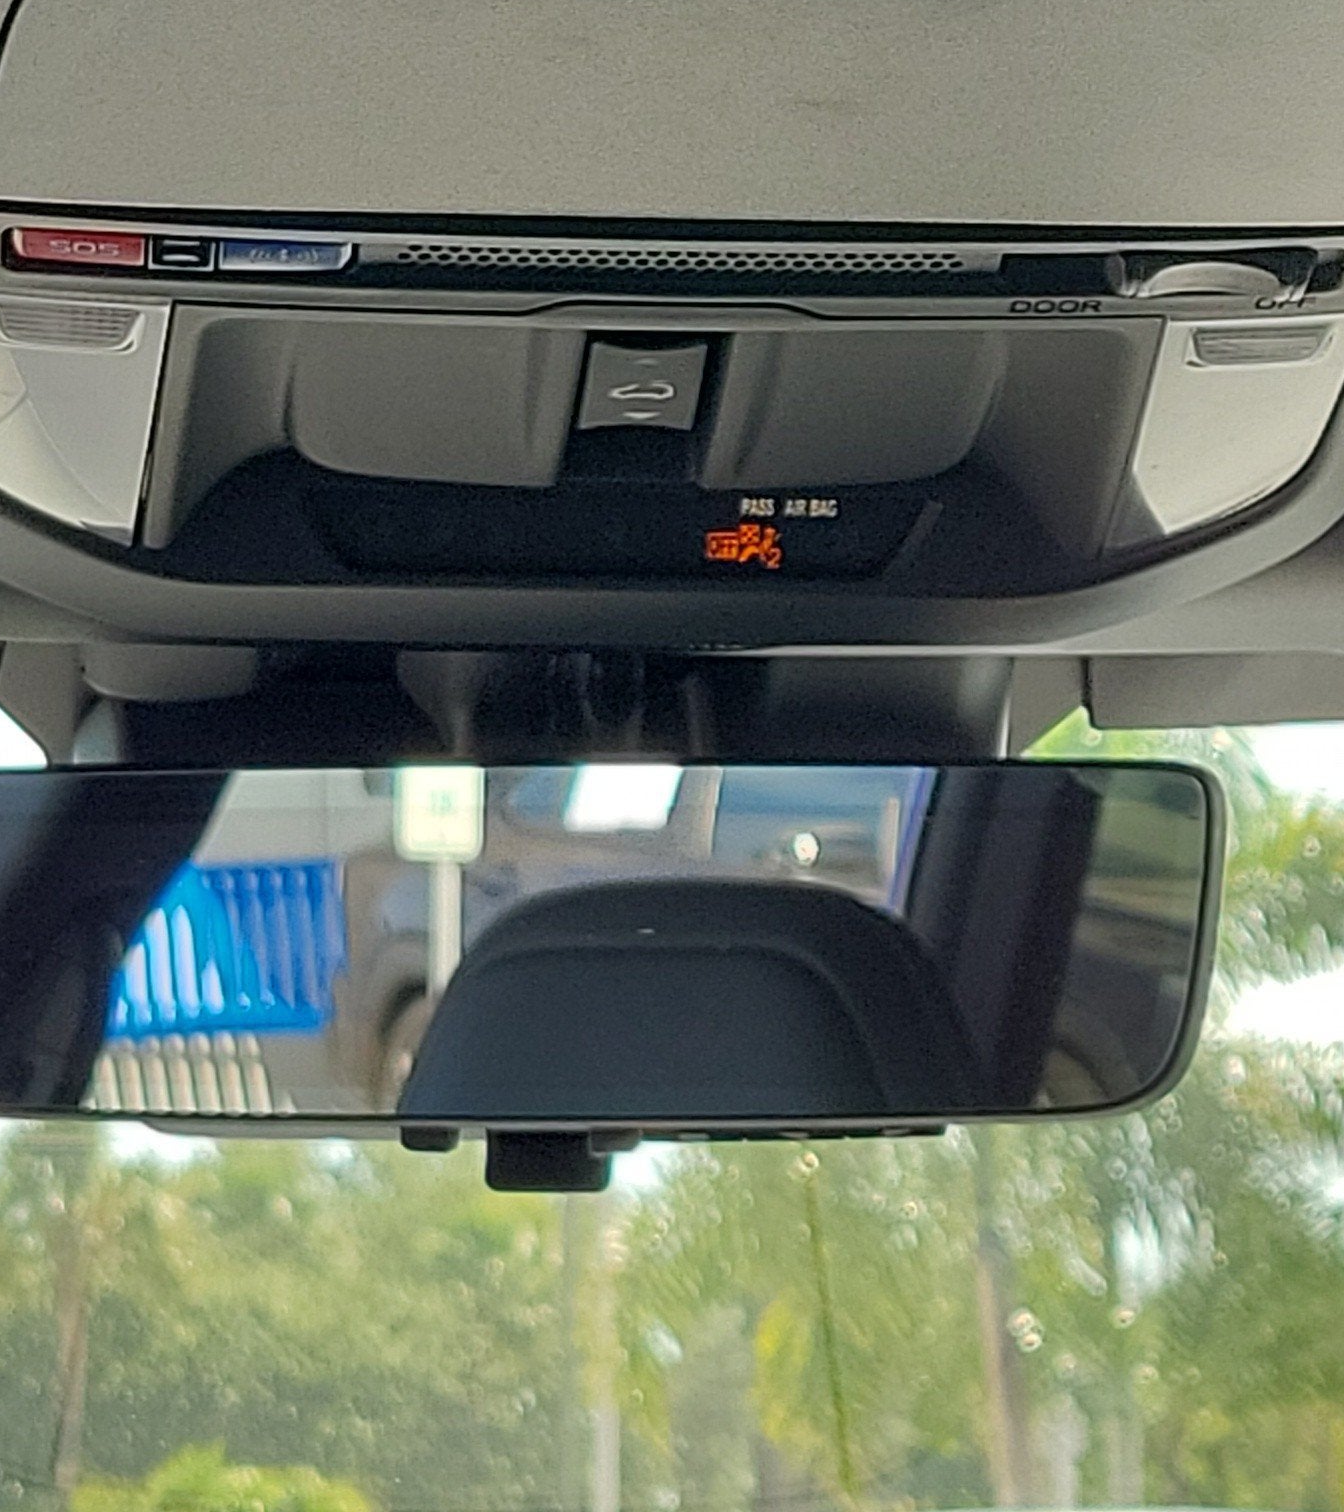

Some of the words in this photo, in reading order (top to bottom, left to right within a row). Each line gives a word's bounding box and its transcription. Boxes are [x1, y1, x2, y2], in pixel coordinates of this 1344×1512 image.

[49, 239, 119, 257] SOS
[1009, 299, 1102, 314] DOOR
[741, 498, 775, 517] PASS
[784, 499, 807, 517] AIR
[809, 499, 838, 518] BAG
